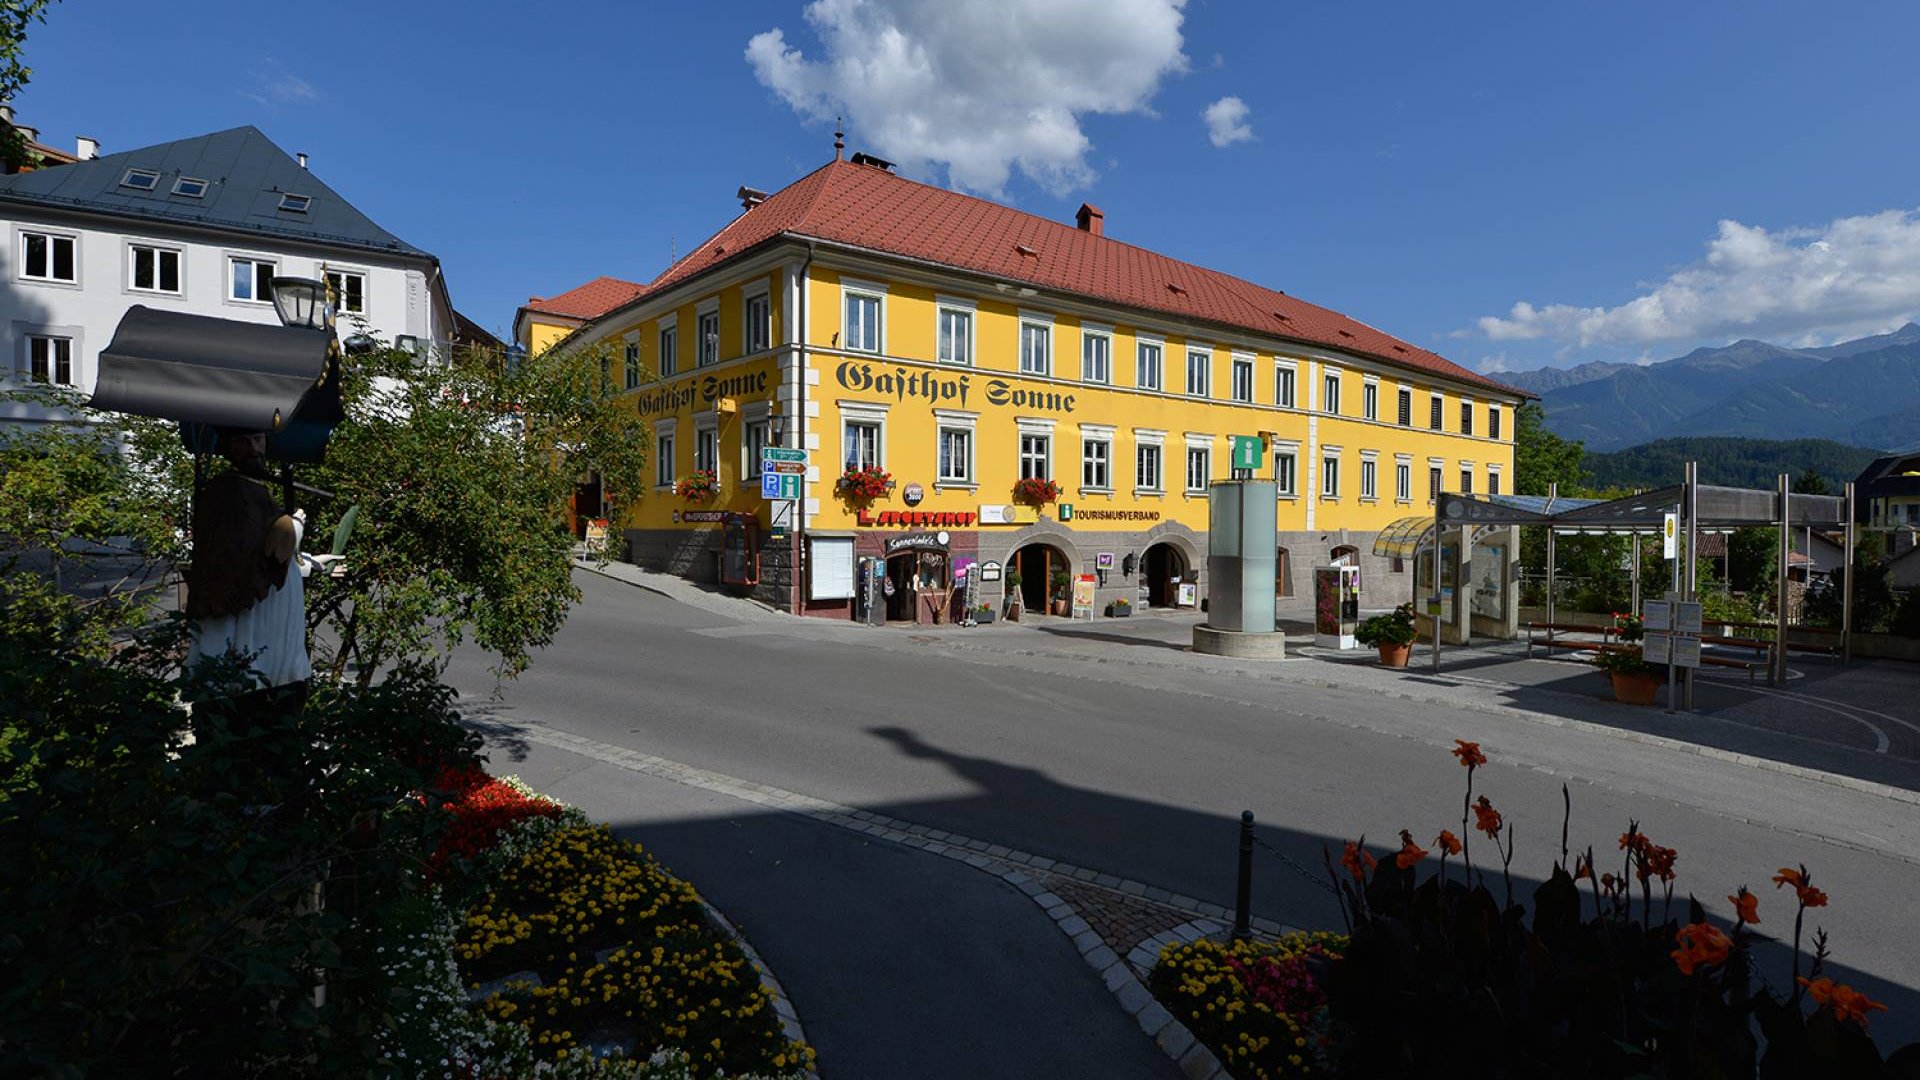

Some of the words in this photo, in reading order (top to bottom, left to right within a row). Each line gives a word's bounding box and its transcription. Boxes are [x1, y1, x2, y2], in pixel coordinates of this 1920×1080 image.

[638, 380, 696, 417] Gasthof
[702, 370, 768, 402] Sonne
[835, 361, 970, 408] Gasthof
[984, 379, 1076, 413] Sonne
[766, 475, 777, 490] P
[879, 511, 977, 525] SPORTSHOP
[1074, 509, 1160, 521] TOURISMUSVERBAND
